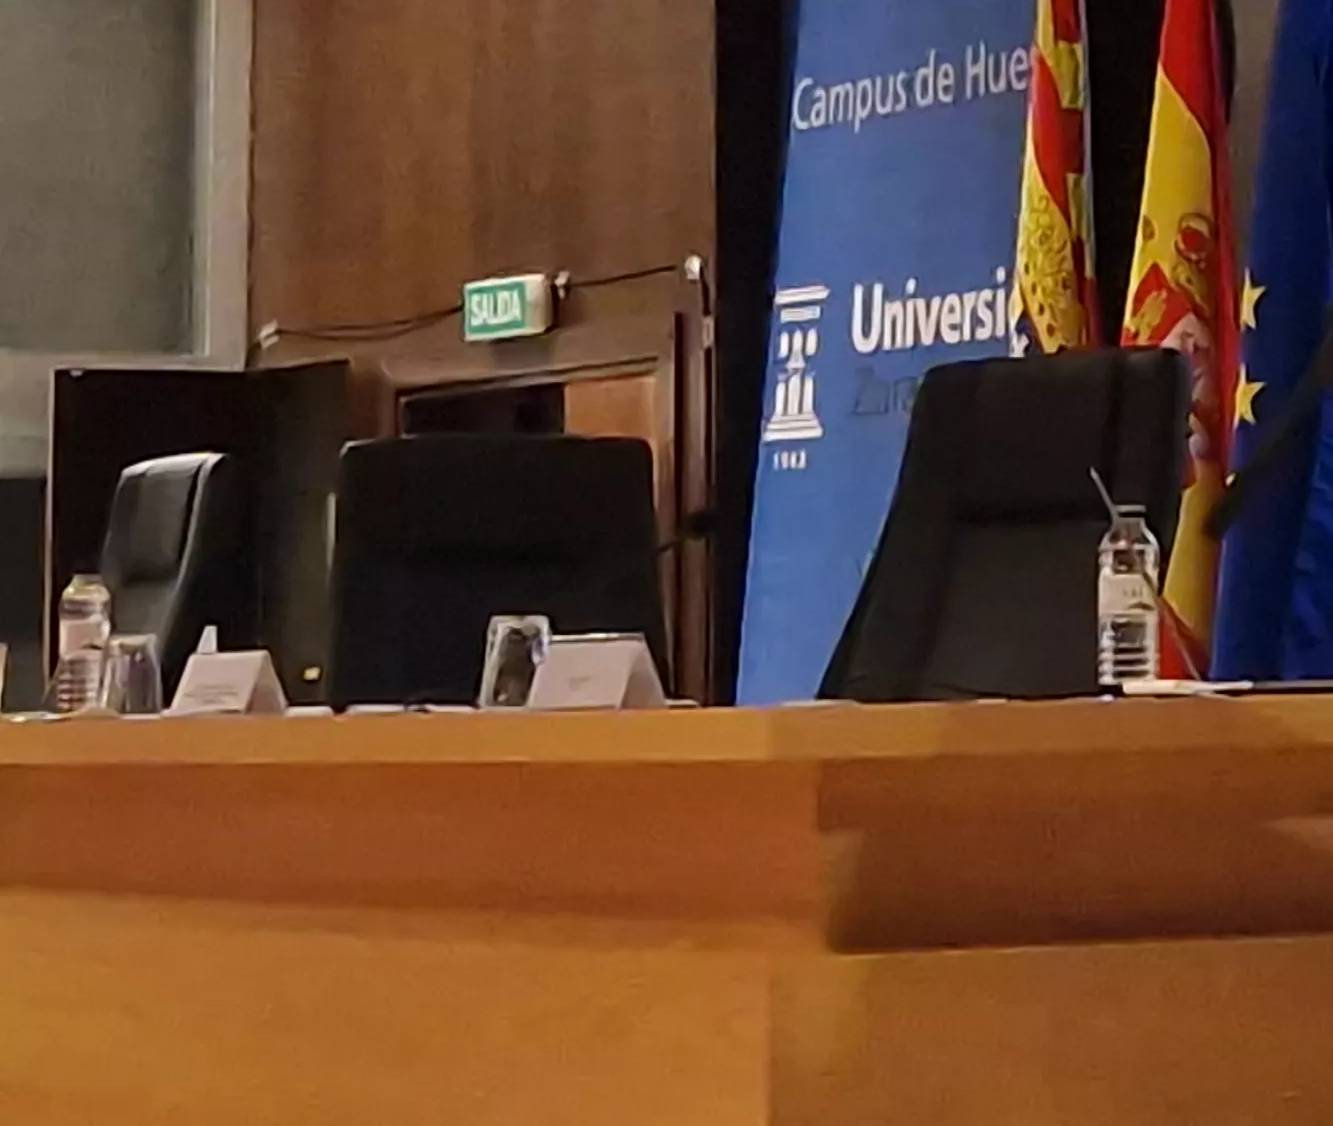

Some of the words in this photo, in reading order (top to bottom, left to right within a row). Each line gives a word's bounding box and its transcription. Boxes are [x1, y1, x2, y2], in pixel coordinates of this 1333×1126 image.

[793, 77, 907, 134] Campus
[914, 48, 954, 108] de
[471, 290, 522, 327] SALIDA
